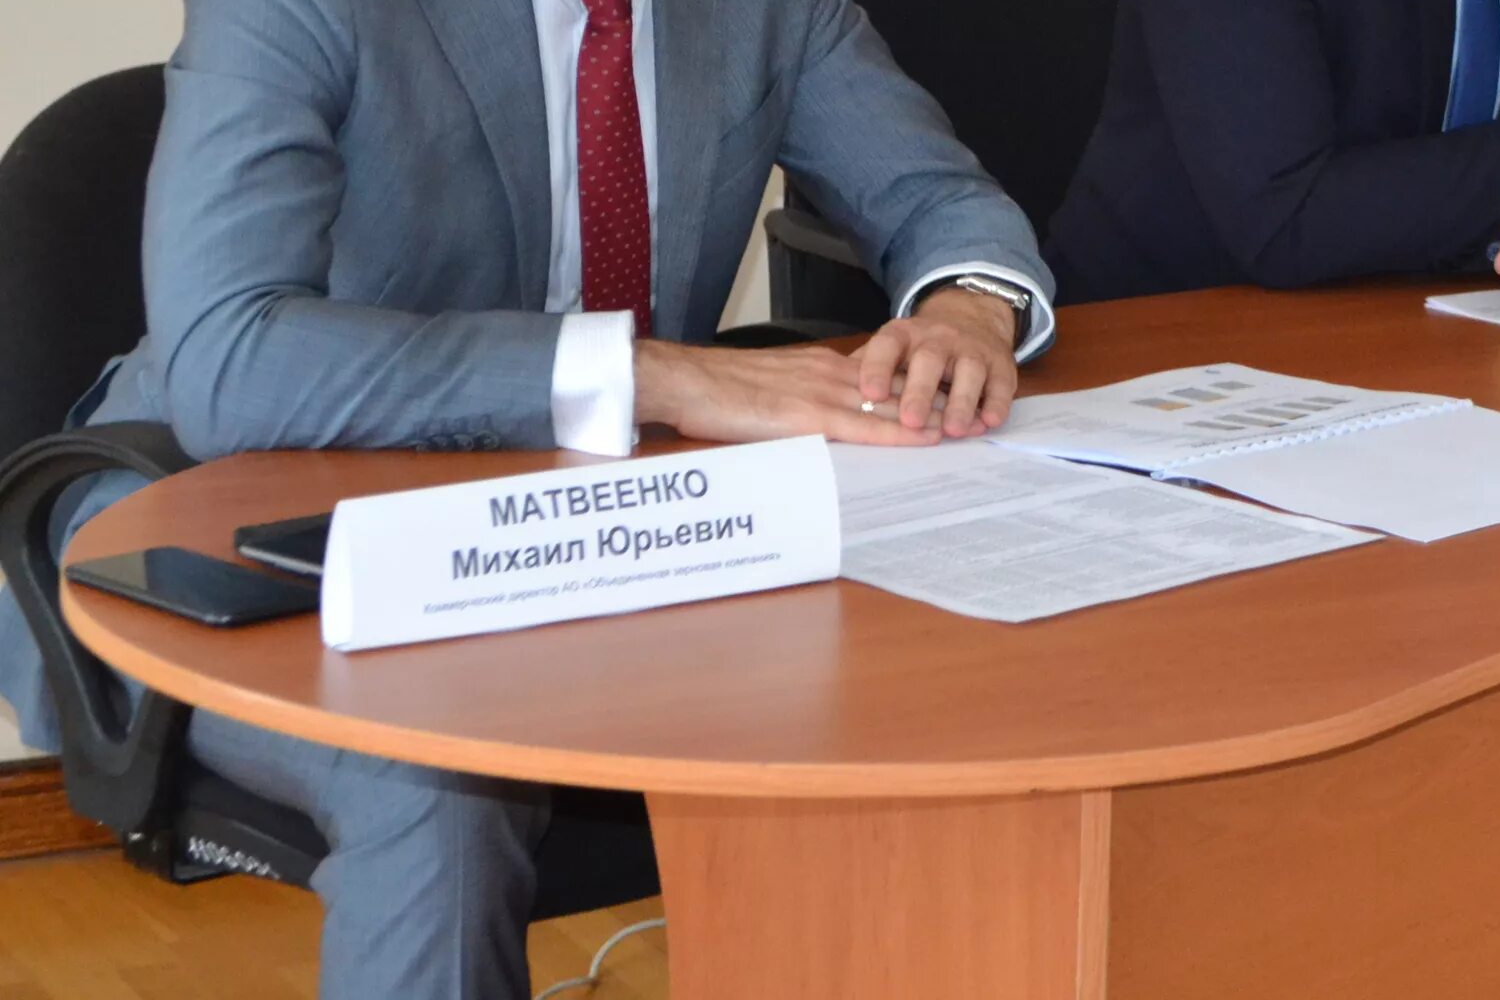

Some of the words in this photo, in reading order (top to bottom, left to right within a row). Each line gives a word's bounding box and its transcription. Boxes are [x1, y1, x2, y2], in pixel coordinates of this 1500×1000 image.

[489, 468, 710, 528] МАТВЕЕНКО
[451, 537, 585, 581] Михаил
[597, 511, 755, 561] Юрьевич
